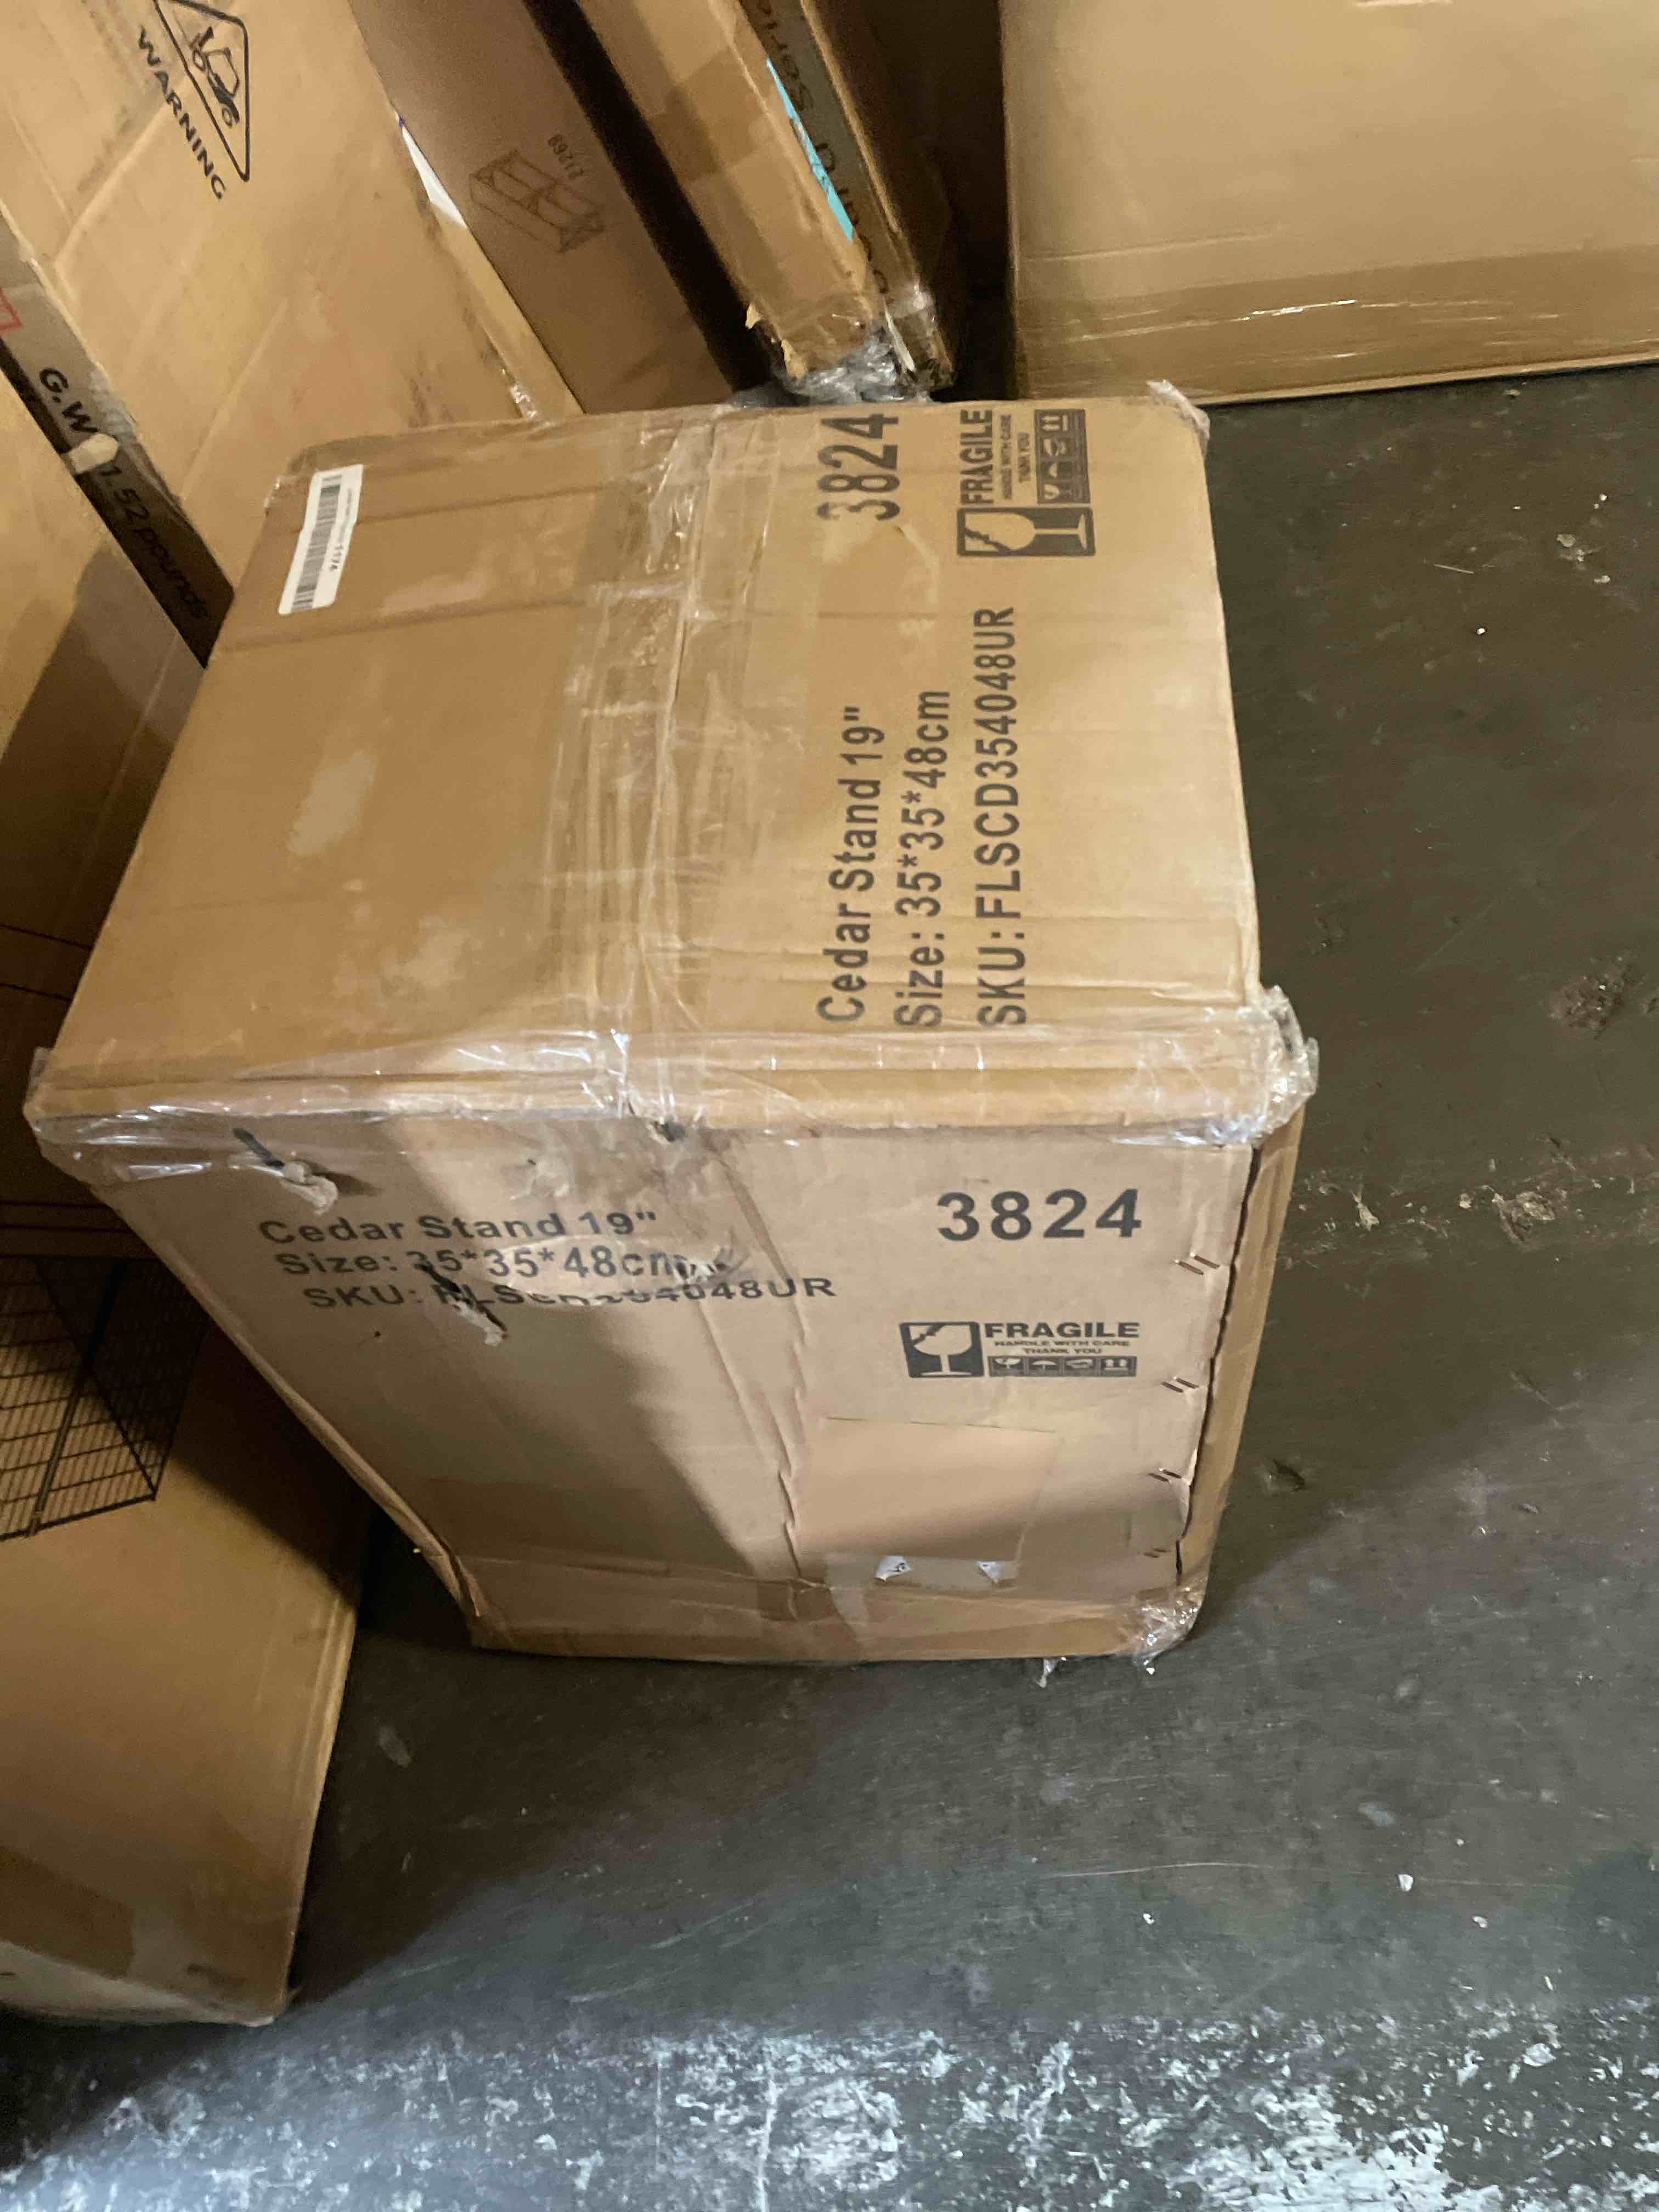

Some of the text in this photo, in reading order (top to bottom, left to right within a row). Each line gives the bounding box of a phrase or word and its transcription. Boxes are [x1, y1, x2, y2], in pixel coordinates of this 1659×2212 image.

[138, 24, 225, 199] WARNING
[817, 413, 900, 521] 3824
[959, 409, 994, 505] FRAGILE
[1000, 441, 1012, 465] WITH
[973, 606, 1027, 1028] SKU: FLSCD354048UR
[816, 706, 885, 1024] Cedar Stand 19"
[893, 932, 945, 1029] Size:
[258, 1210, 656, 1244] Cedar Stand 19"
[937, 1188, 1142, 1241] 3824
[275, 1251, 398, 1275] Size:
[302, 1284, 422, 1308] SKU:
[984, 1322, 1140, 1338] FRAGILE
